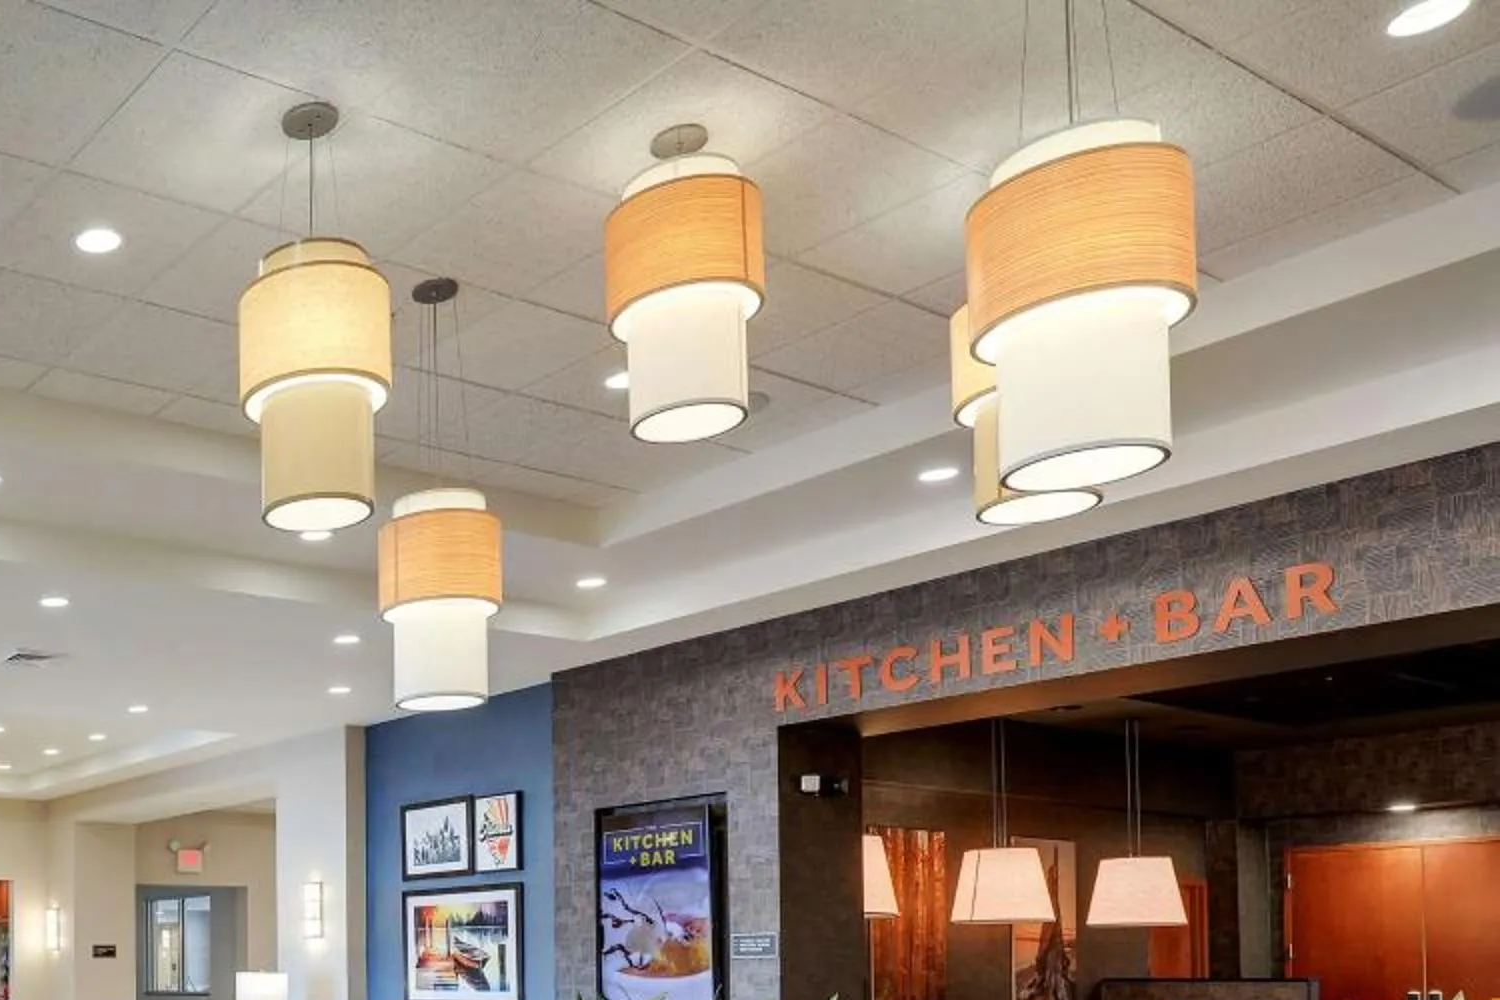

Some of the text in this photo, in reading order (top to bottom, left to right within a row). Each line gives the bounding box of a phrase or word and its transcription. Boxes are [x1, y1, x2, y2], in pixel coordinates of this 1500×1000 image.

[772, 611, 1076, 713] KITCHEN
[1154, 560, 1340, 645] BAR
[612, 828, 694, 853] KITCHEN
[640, 849, 676, 867] BAR
